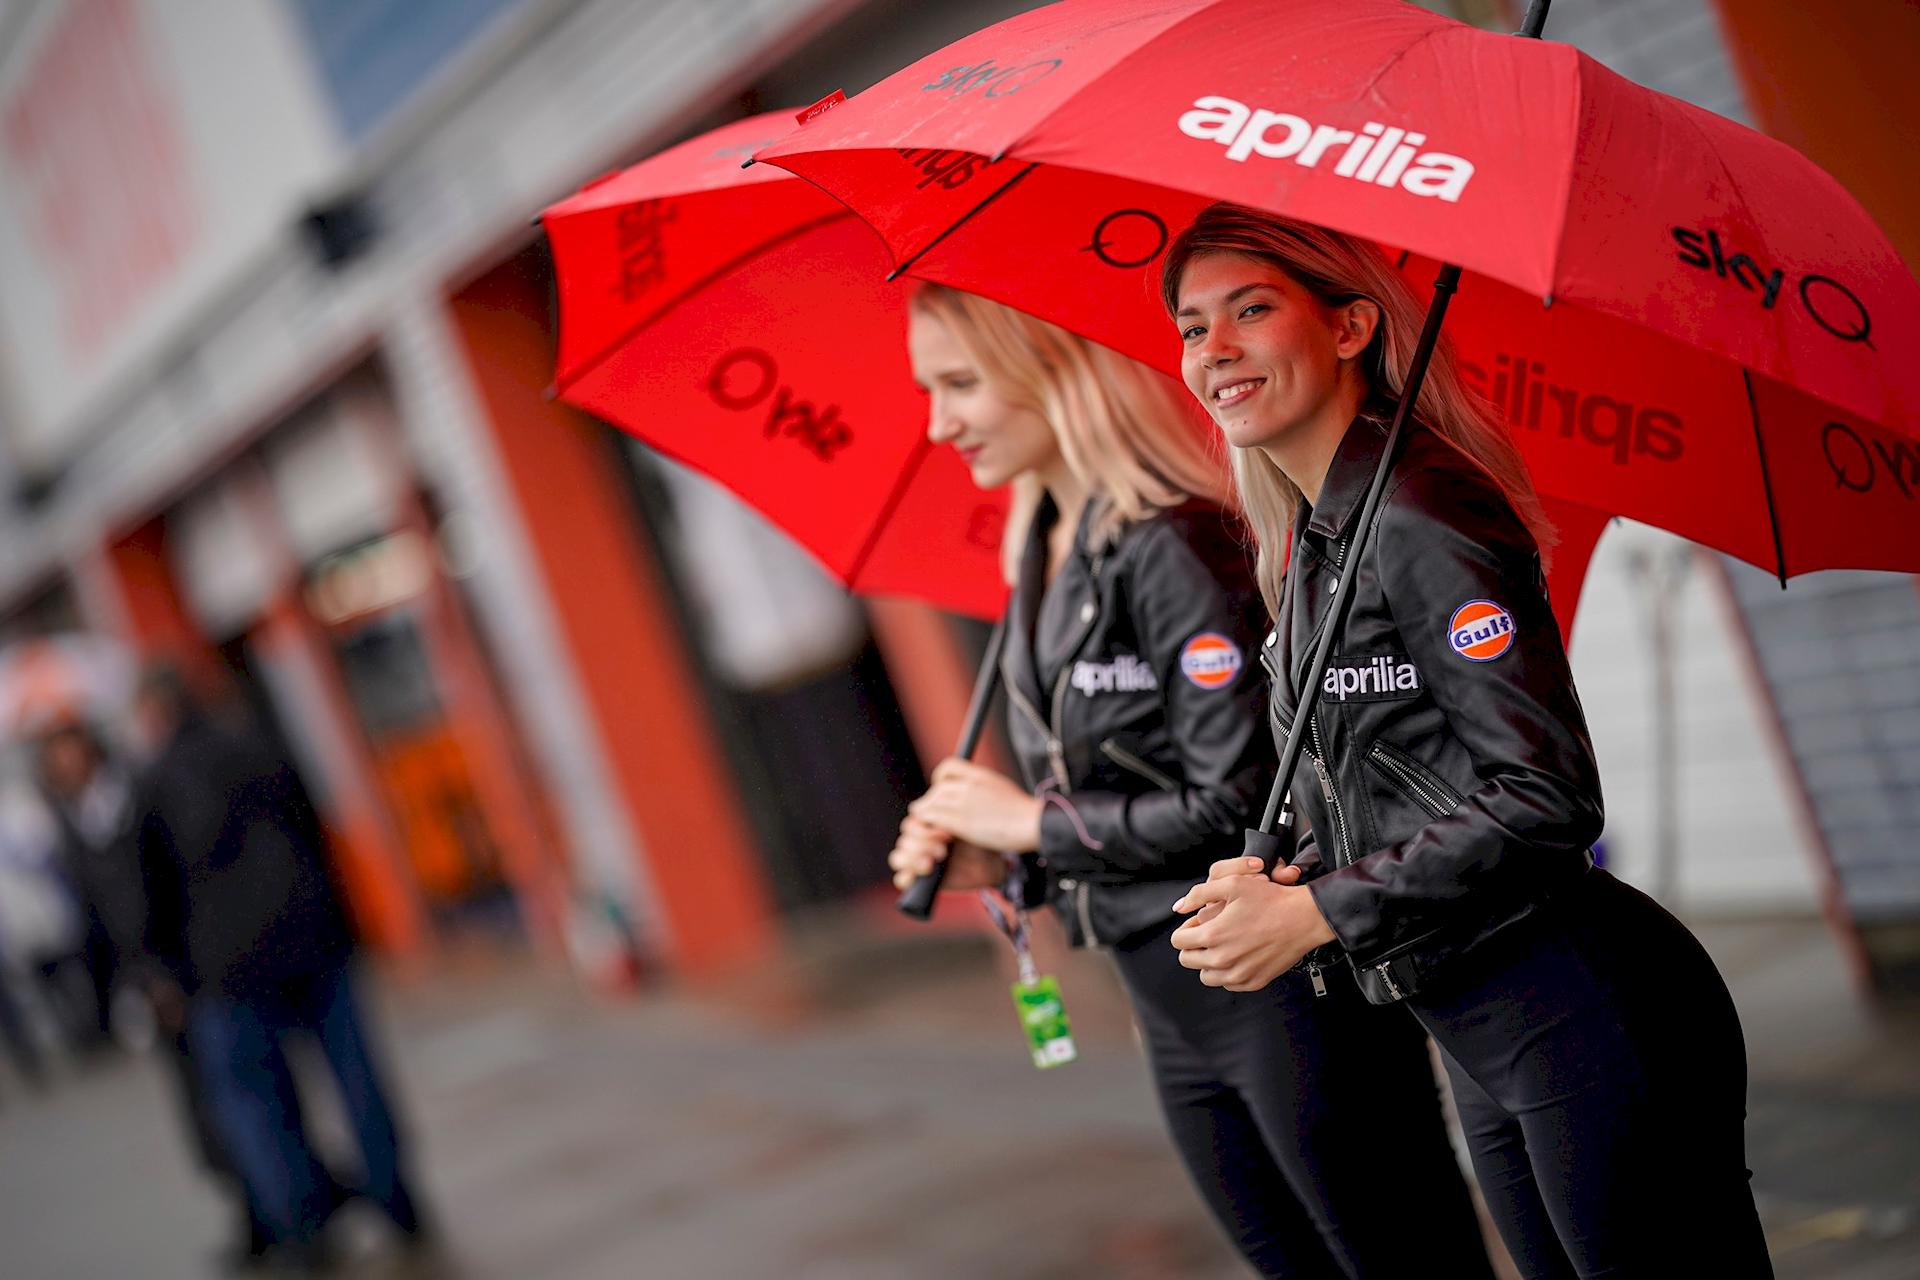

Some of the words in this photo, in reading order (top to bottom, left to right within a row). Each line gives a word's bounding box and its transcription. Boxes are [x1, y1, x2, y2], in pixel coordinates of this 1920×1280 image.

[1177, 95, 1476, 203] aprilia
[1671, 226, 1785, 309] sky
[1799, 273, 1877, 352] Q
[1454, 613, 1512, 649] Gulf
[1071, 653, 1159, 698] aprilia
[1323, 655, 1420, 701] aprilia
